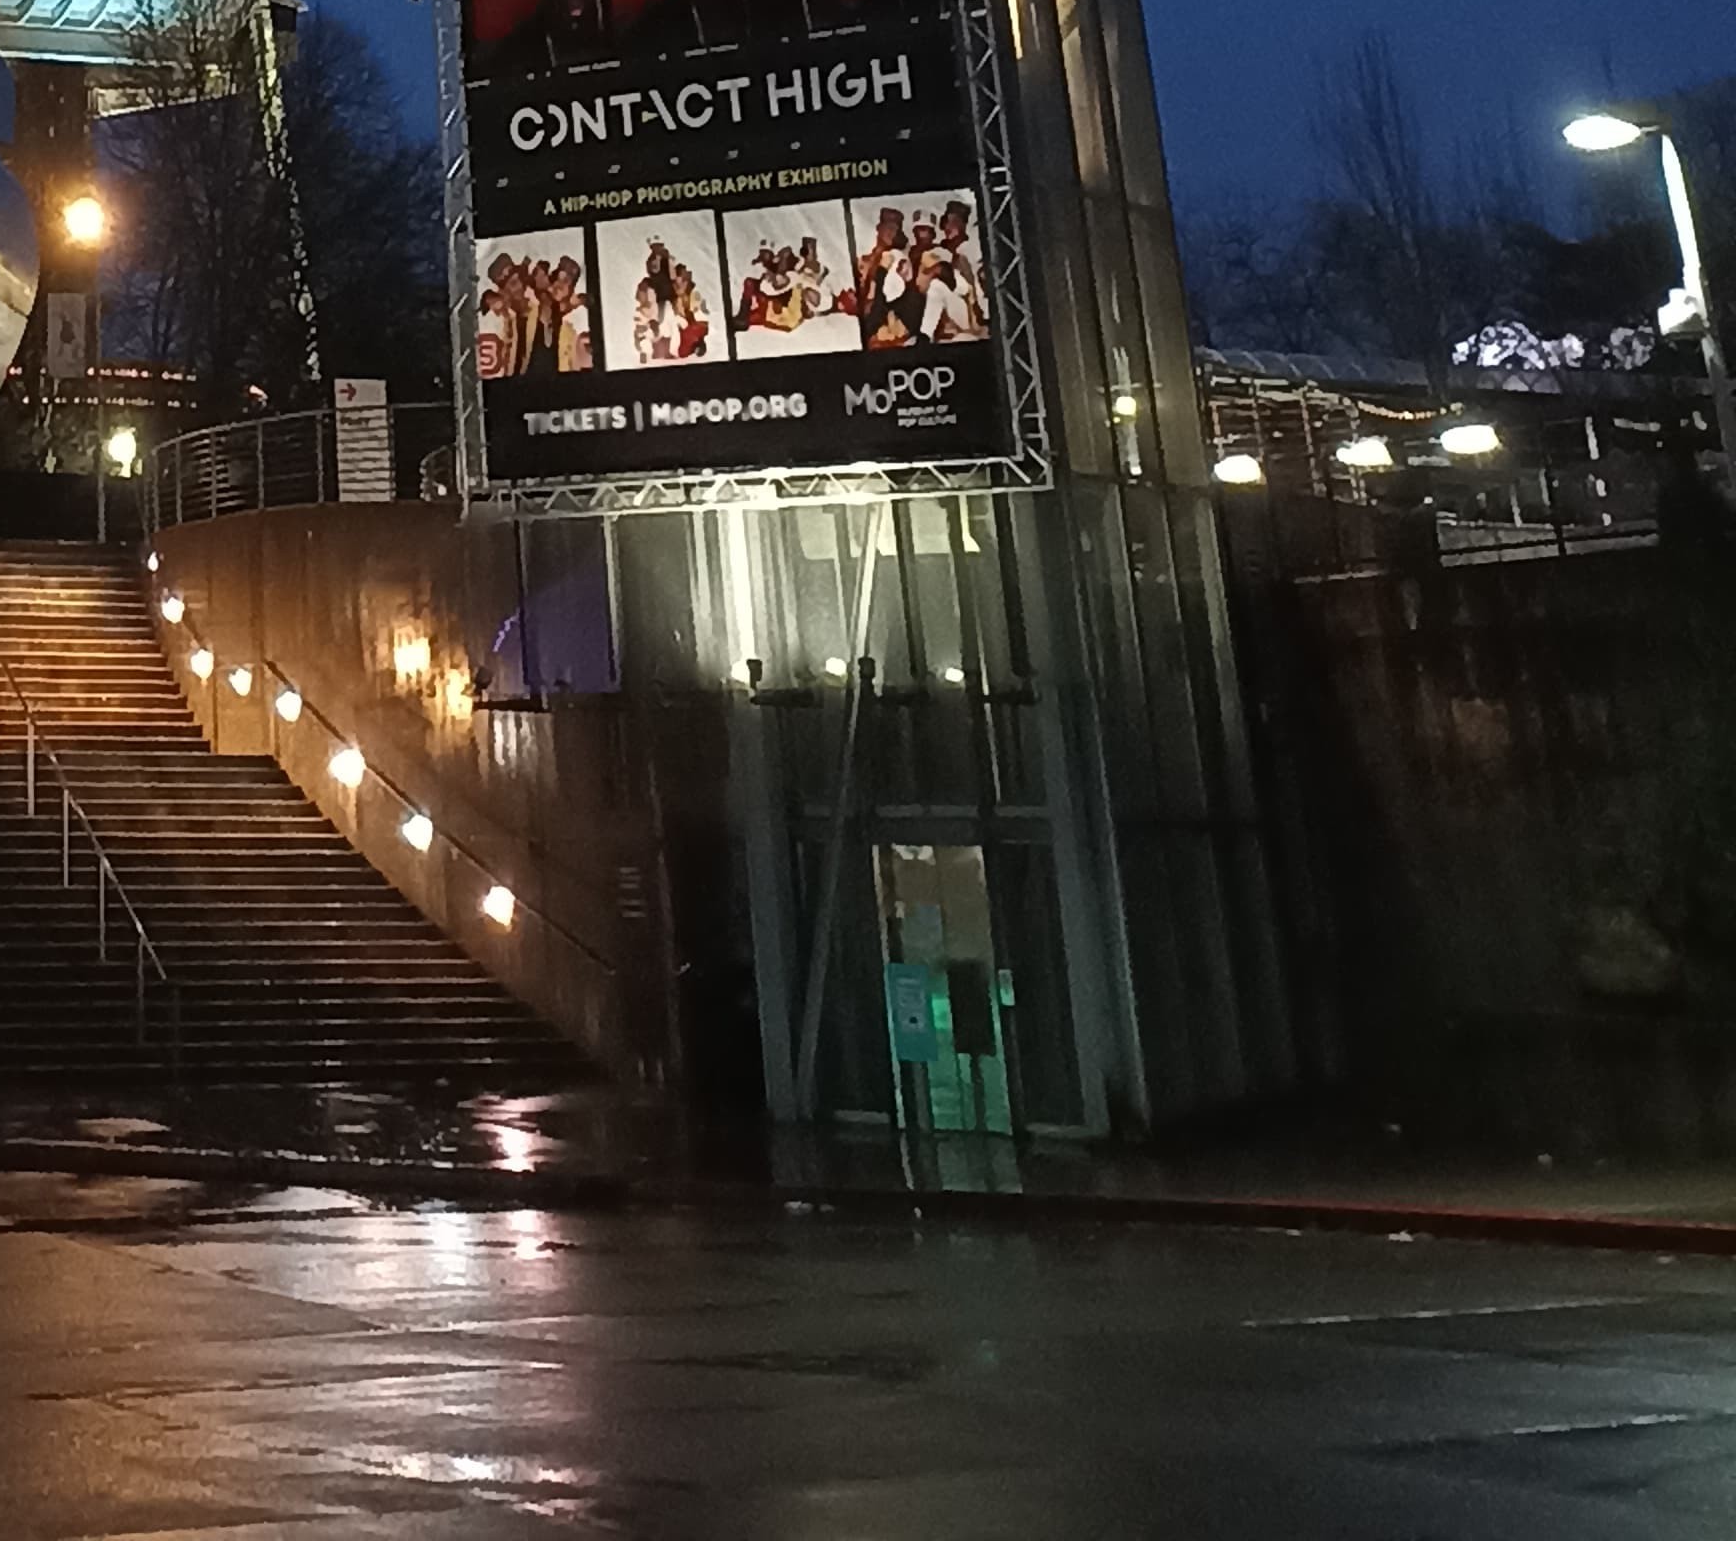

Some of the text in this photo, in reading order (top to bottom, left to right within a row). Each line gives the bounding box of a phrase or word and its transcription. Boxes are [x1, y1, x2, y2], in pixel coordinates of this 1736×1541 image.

[509, 54, 913, 151] CONTACT HIGH
[544, 158, 888, 215] A HIP-HOP PHOTOGRAPHY EXHIBITION
[523, 393, 807, 436] TICKETS MoPOP.ORG
[843, 366, 956, 416] MoPOP
